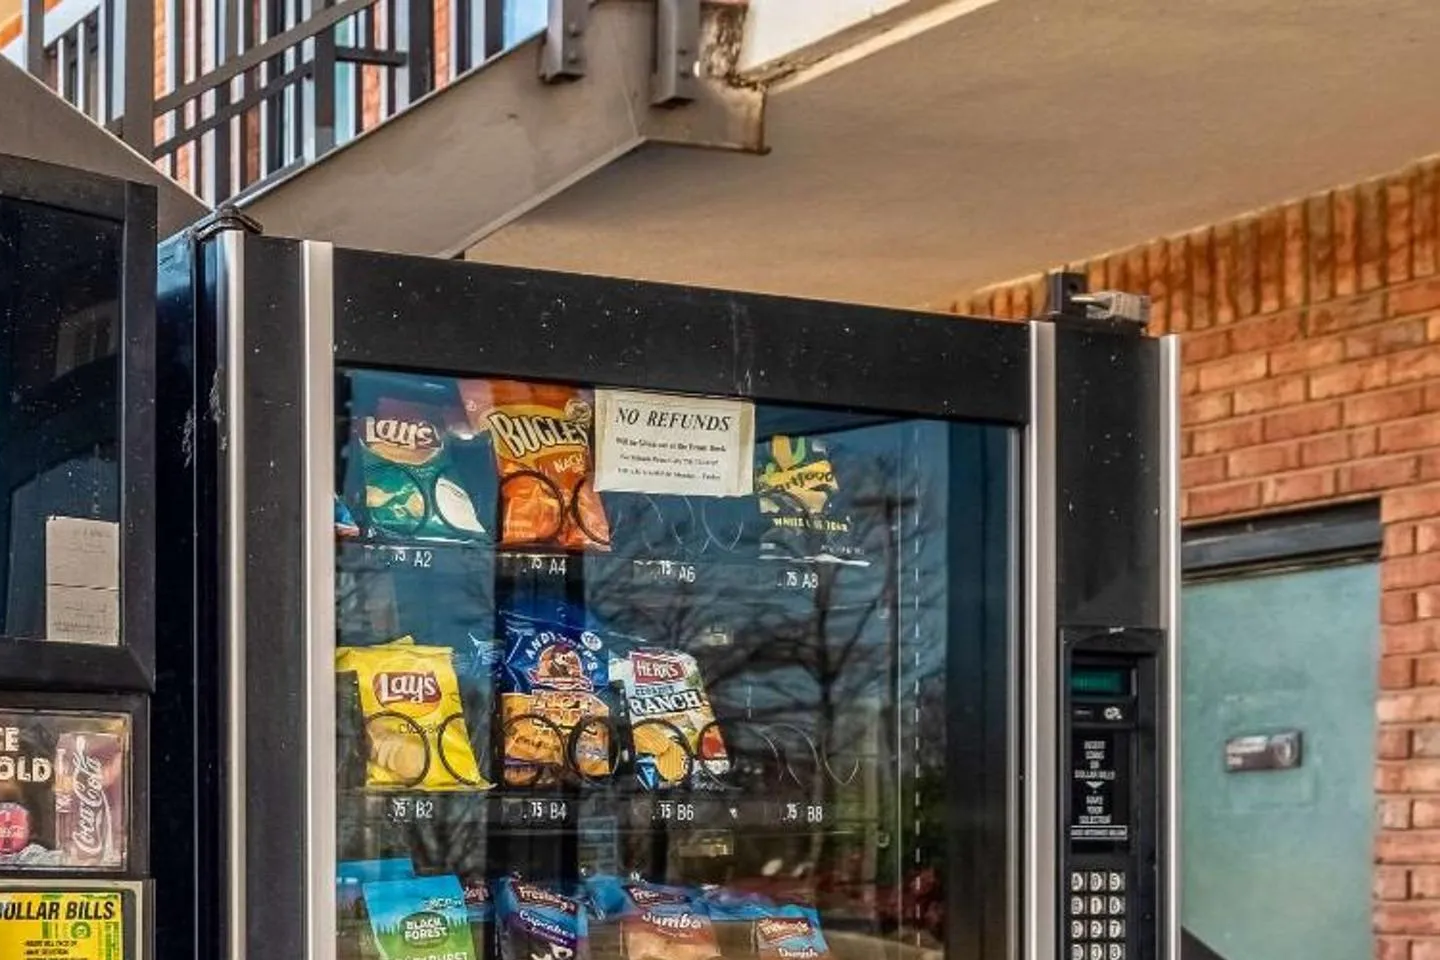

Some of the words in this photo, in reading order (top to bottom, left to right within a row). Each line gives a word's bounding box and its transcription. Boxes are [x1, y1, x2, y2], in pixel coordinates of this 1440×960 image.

[616, 407, 640, 424] NO
[647, 410, 731, 431] REFUNDS
[366, 416, 434, 449] Lay's
[489, 411, 591, 457] BUGLES
[414, 552, 432, 567] A2
[549, 560, 566, 575] A4
[679, 566, 696, 582] A6
[380, 673, 438, 704] Lay's
[630, 688, 700, 716] RANCH
[416, 801, 433, 818] B2
[550, 803, 567, 819] B4
[677, 803, 694, 820] B6
[807, 805, 823, 822] B8
[65, 901, 115, 920] BILLS
[406, 917, 441, 931] BLACK
[642, 912, 703, 930] Jumbo
[404, 926, 448, 940] FOREST
